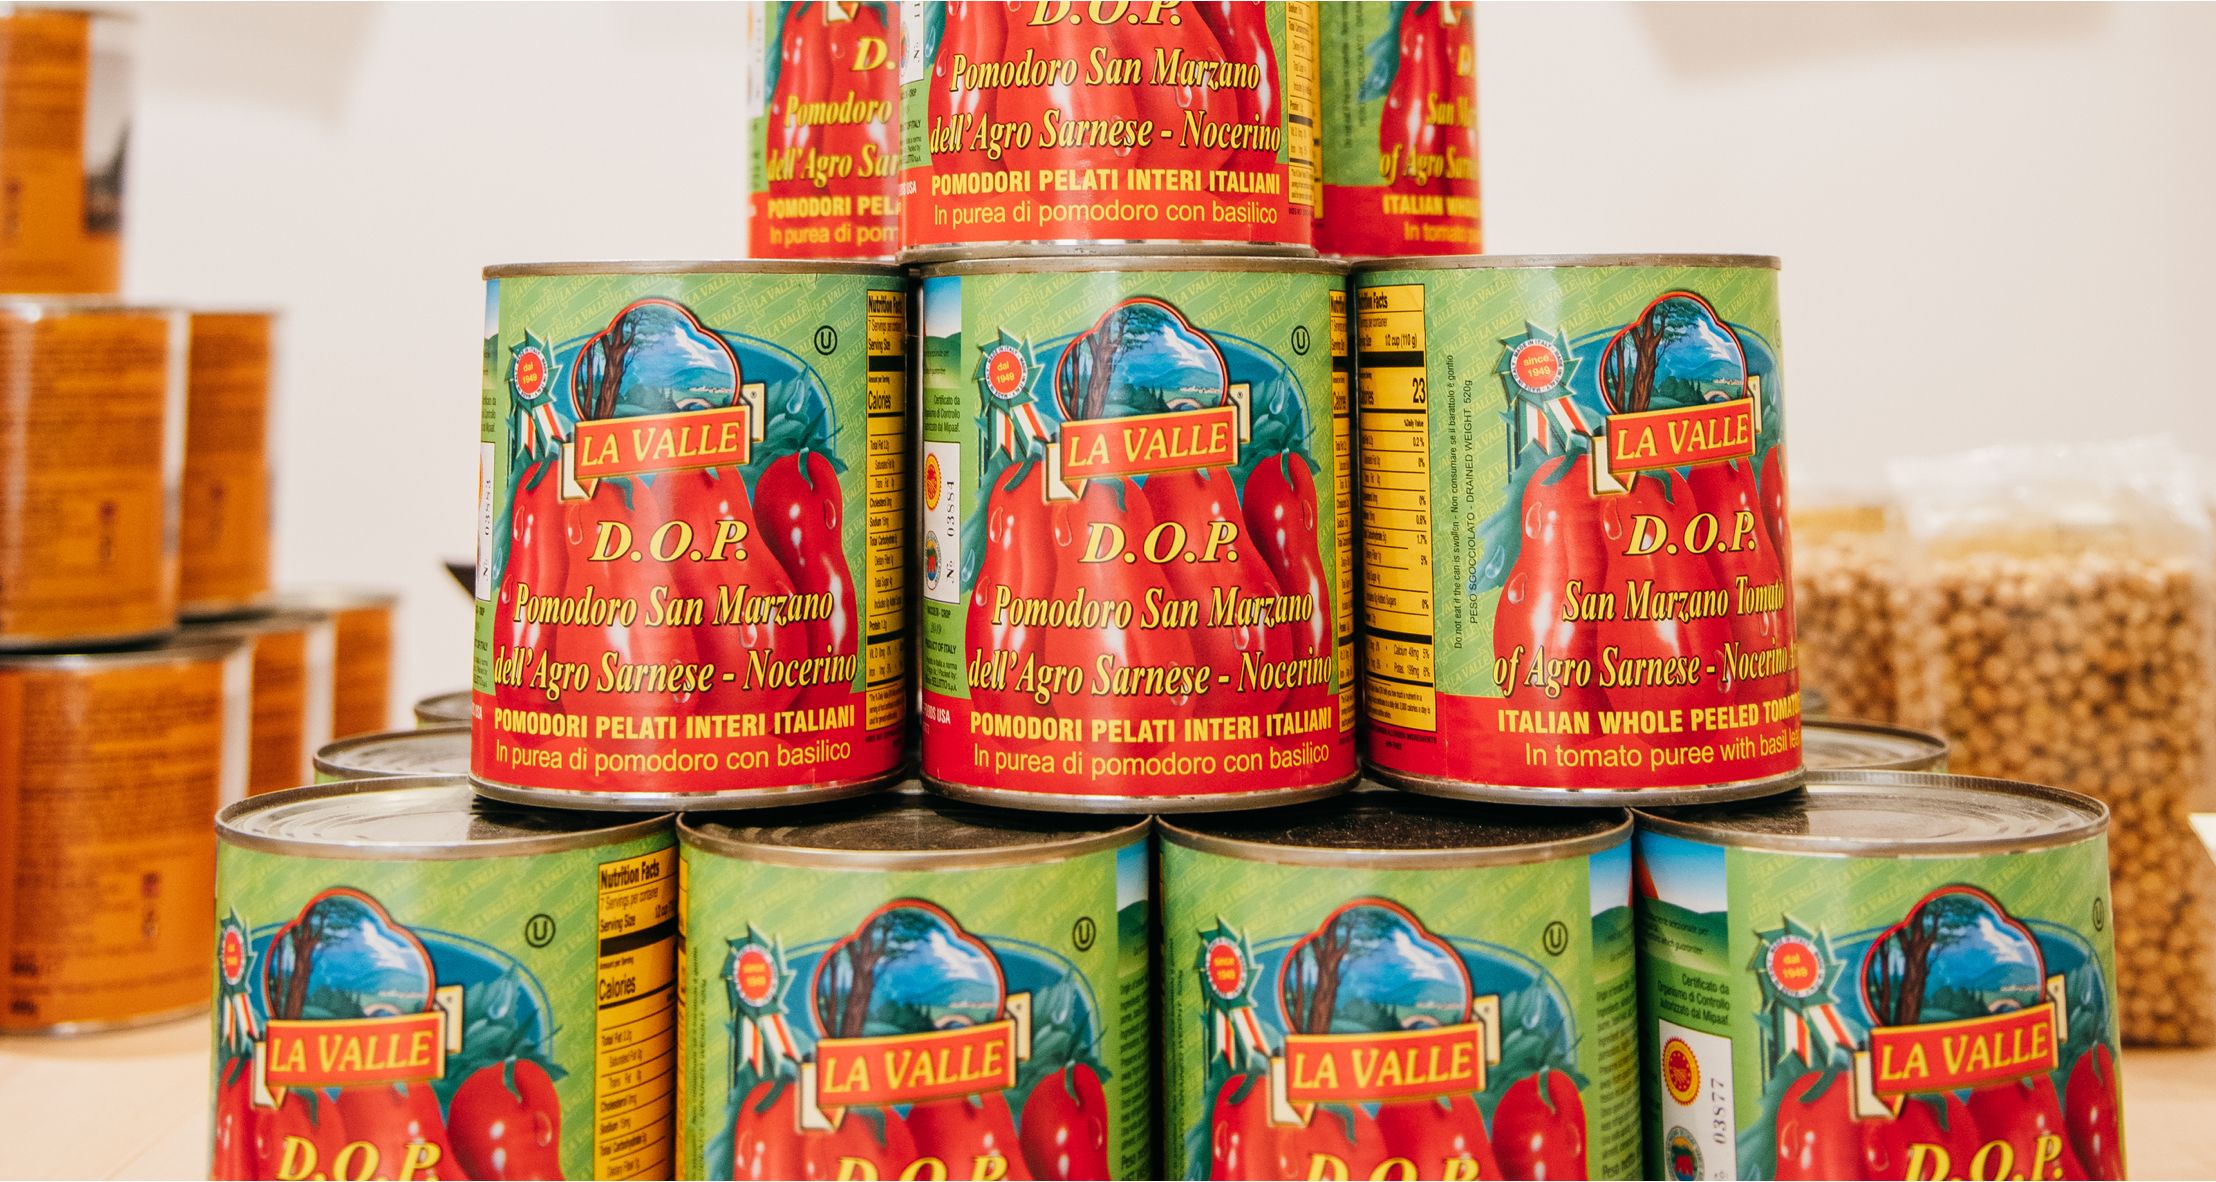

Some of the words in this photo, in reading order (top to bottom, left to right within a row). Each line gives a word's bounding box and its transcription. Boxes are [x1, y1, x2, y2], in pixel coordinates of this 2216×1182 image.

[950, 48, 1078, 91] Pomodoro
[1084, 47, 1141, 85] San
[1150, 47, 1261, 90] Marzano
[784, 91, 893, 129] Pomodoro
[1039, 109, 1153, 148] Sarnese
[1180, 110, 1281, 152] Nocerino
[1381, 143, 1402, 186] of
[931, 170, 1031, 196] POMODORI
[1039, 168, 1119, 192] PELATI
[1127, 168, 1202, 192] INTERI
[1209, 170, 1280, 194] ITALIANI
[767, 196, 851, 219] POMODORI
[935, 205, 947, 225] In
[952, 206, 1006, 229] purea
[1012, 200, 1031, 223] di
[1039, 199, 1159, 227] pomodoro
[1165, 204, 1205, 221] con
[1212, 200, 1277, 224] basilico
[770, 227, 782, 244] In
[785, 227, 829, 249] purea
[835, 222, 851, 242] di
[1373, 292, 1388, 309] Facts
[523, 362, 534, 372] dal
[997, 361, 1009, 371] dal
[997, 372, 1015, 383] 1949
[1446, 354, 1454, 380] gonfio
[1523, 355, 1549, 366] since
[1528, 366, 1551, 378] 1949
[523, 373, 537, 384] 1949
[1413, 378, 1425, 404] 23
[1463, 379, 1473, 404] 520g
[869, 390, 891, 410] Calories
[1448, 388, 1456, 425] barattolo
[581, 433, 619, 467] LA
[632, 421, 740, 461] VALLE
[1068, 434, 1110, 467] LA
[1123, 421, 1229, 462] VALLE
[1451, 435, 1457, 444] se
[1615, 427, 1657, 461] LA
[1667, 413, 1749, 454] VALLE
[1465, 454, 1475, 503] DRAINED
[1451, 496, 1459, 513] Non
[591, 519, 748, 562] D.O.P.
[1082, 521, 1238, 563] D.O.P.
[1452, 521, 1460, 553] swollen
[1627, 511, 1755, 555] D.O.P.
[1467, 512, 1478, 590] SGOCCIOLATO
[514, 582, 638, 628] Pomodoro
[644, 586, 704, 627] San
[713, 585, 833, 626] Marzano
[1452, 582, 1462, 598] the
[1562, 581, 1615, 624] San
[1624, 580, 1729, 624] Marzano
[1735, 576, 1785, 615] Tomato
[992, 585, 1133, 630] Pomodoro
[1140, 588, 1199, 628] San
[1208, 586, 1314, 629] Marzano
[1454, 606, 1462, 618] eat
[1470, 593, 1479, 624] PESO
[1454, 619, 1463, 635] not
[1454, 636, 1463, 649] Do
[596, 652, 715, 693] Sarnese
[743, 645, 857, 691] Nocerino
[1091, 655, 1211, 696] Sarnese
[1237, 647, 1332, 695] Nocerino
[1493, 645, 1524, 698] of
[1525, 648, 1591, 698] Agro
[1599, 647, 1700, 687] Sarnese
[1723, 638, 1789, 682] Nocerino
[494, 707, 588, 738] POMODORI
[595, 715, 677, 740] PELATI
[685, 713, 766, 739] INTERI
[774, 704, 855, 735] ITALIANI
[937, 707, 950, 725] USA
[970, 711, 1083, 742] POMODORI
[1091, 719, 1175, 743] PELATI
[1184, 715, 1259, 742] INTERI
[1266, 707, 1332, 737] ITALIANI
[1498, 709, 1590, 734] ITALIAN
[1598, 709, 1683, 734] WHOLE
[1691, 703, 1760, 731] PEELED
[496, 741, 508, 761] In
[511, 747, 563, 769] purea
[569, 742, 587, 769] di
[595, 743, 719, 776] pomodoro
[726, 751, 769, 770] con
[777, 740, 851, 766] basilico
[975, 745, 989, 767] In
[995, 751, 1055, 773] purea
[1062, 751, 1083, 775] di
[1091, 751, 1216, 781] pomodoro
[1223, 749, 1263, 774] con
[1270, 744, 1328, 769] basilico
[1525, 742, 1547, 765] In
[1555, 745, 1642, 767] tomato
[1650, 740, 1714, 772] puree
[1720, 737, 1755, 760] with
[1760, 729, 1787, 757] basil
[601, 864, 639, 889] Nutrition
[641, 858, 660, 881] Facts
[599, 973, 636, 1000] Calories
[1682, 974, 1718, 993] Certificato
[1720, 983, 1730, 995] da
[1696, 993, 1730, 1011] Controllo
[270, 1038, 306, 1073] LA
[319, 1030, 433, 1073] VALLE
[823, 1056, 870, 1093] LA
[884, 1039, 1004, 1090] VALLE
[1293, 1053, 1338, 1089] LA
[1351, 1042, 1473, 1089] VALLE
[1881, 1043, 1929, 1080] LA
[1943, 1022, 2048, 1074] VALLE
[1711, 1078, 1727, 1144] 03877
